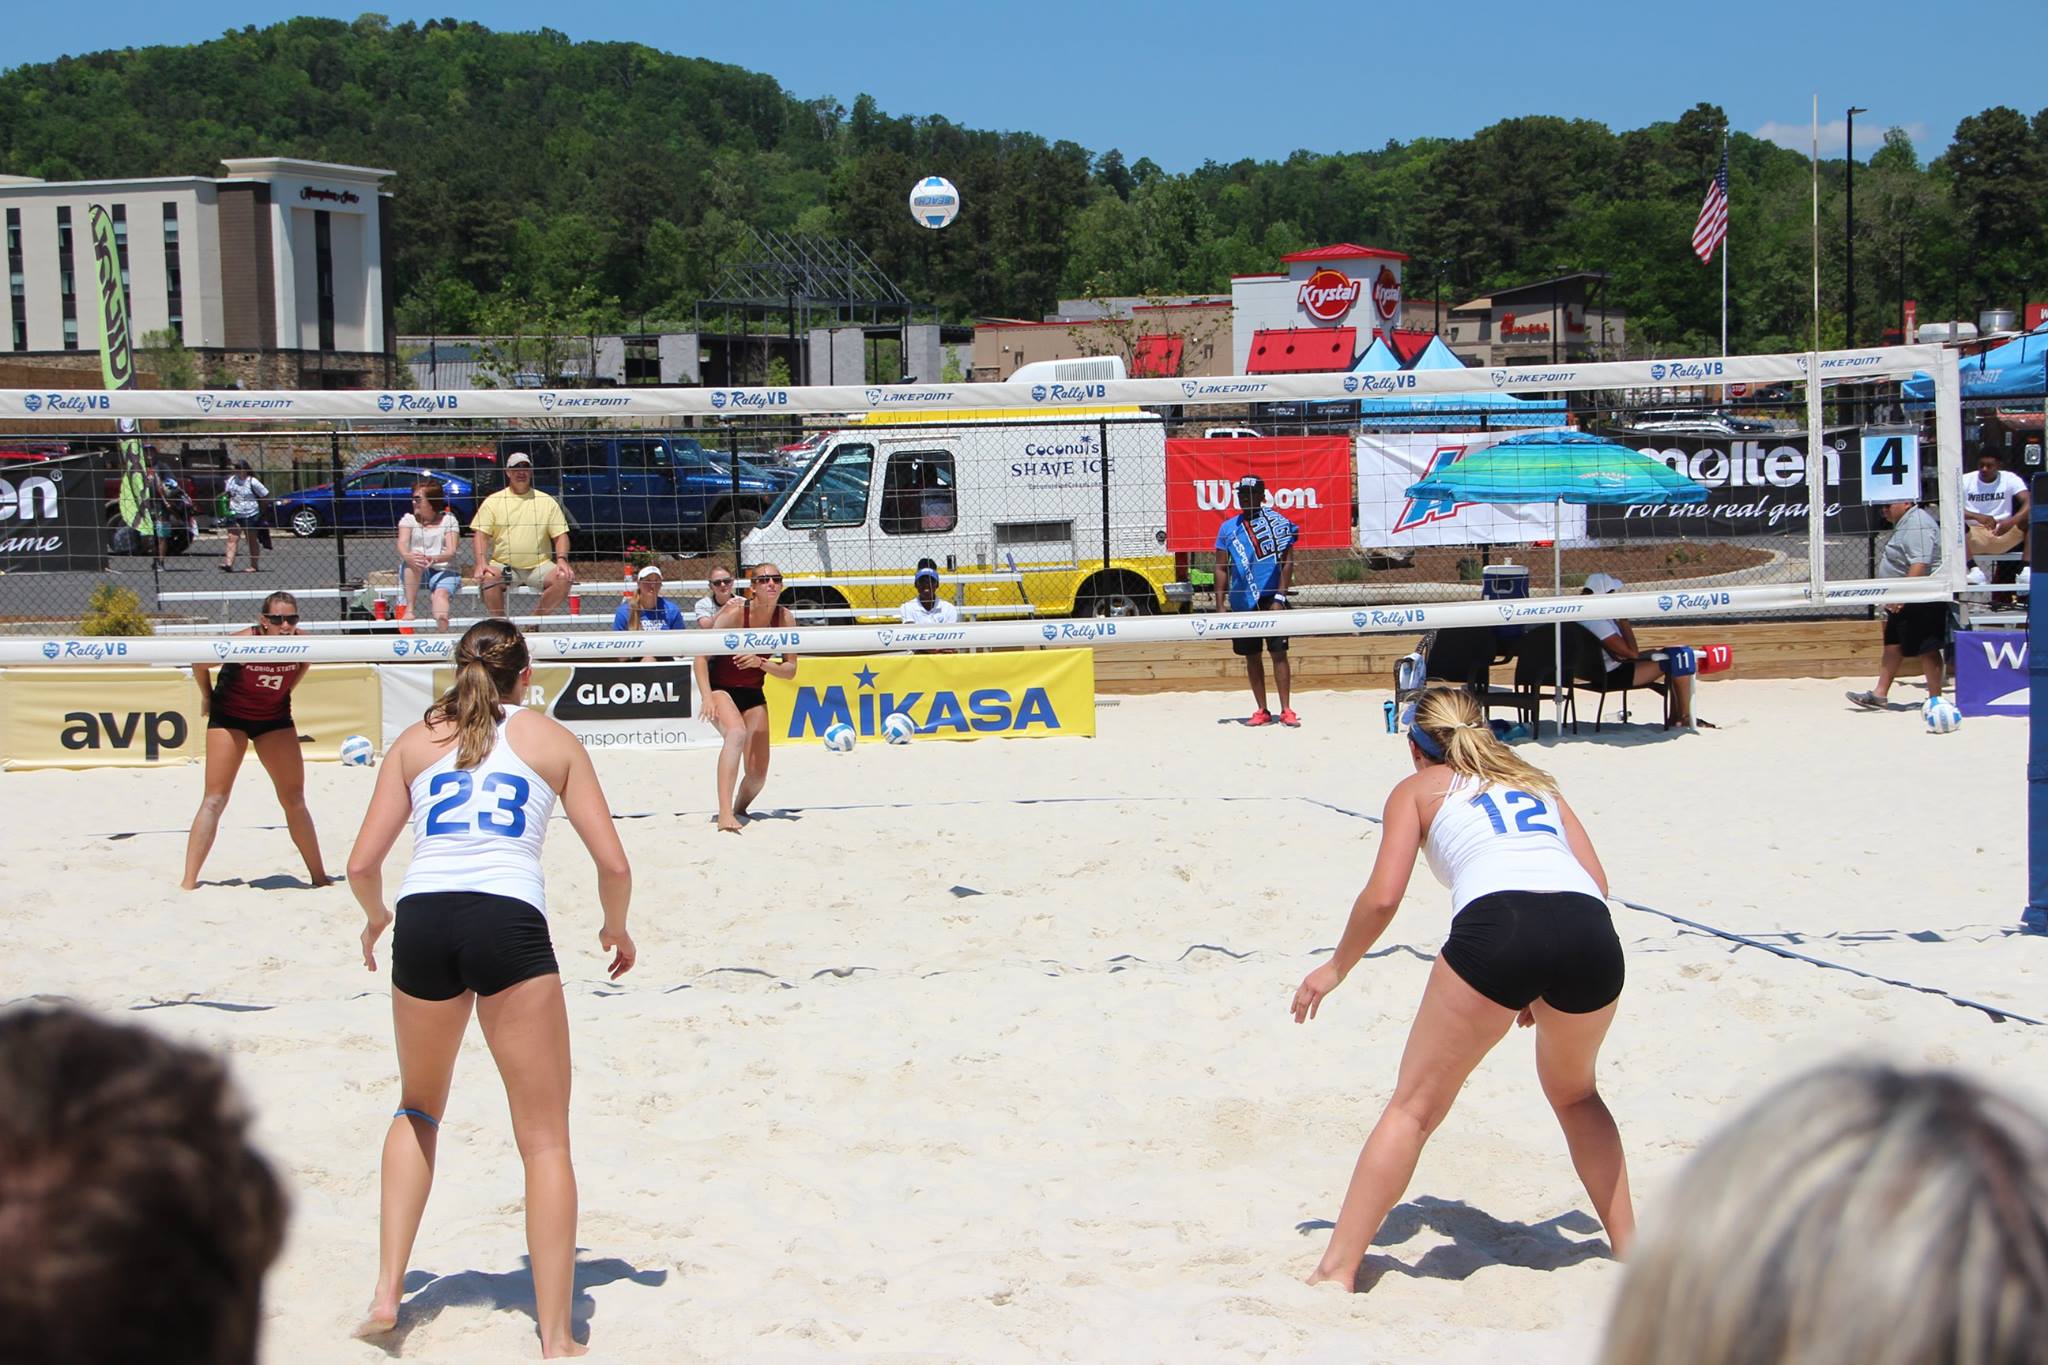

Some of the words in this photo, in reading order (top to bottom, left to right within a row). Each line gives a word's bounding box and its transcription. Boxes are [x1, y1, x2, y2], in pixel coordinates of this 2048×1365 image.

[1299, 283, 1358, 307] Krystal
[1375, 284, 1400, 306] Krystal
[1820, 356, 1883, 368] AKEPOINT
[1508, 372, 1575, 382] LAKEPOINT
[1199, 383, 1268, 393] LAKEPOINT
[558, 397, 630, 406] LAKEPOINT
[883, 392, 954, 402] LAKEPOINT
[217, 400, 294, 409] LAKEPOINT
[1011, 460, 1074, 478] SHAVE
[1083, 457, 1115, 473] ICE
[1871, 437, 1908, 485] 4
[1193, 479, 1317, 510] Wison
[1712, 494, 1770, 519] real
[1826, 588, 1889, 598] AKEPOINT
[1516, 604, 1583, 616] LAKEPOINT
[1209, 620, 1277, 630] LAKEPOINT
[896, 632, 965, 642] LAKEPOINT
[233, 645, 309, 655] LAKEPOINT
[572, 640, 644, 650] LAKEPOINT
[1676, 652, 1689, 669] 11
[1712, 646, 1727, 663] 17
[246, 664, 274, 673] FLORIDA
[276, 664, 296, 672] STATE
[255, 675, 284, 690] 33
[576, 682, 680, 706] GLOBAL
[61, 710, 188, 761] avp
[426, 770, 529, 838] 23
[1471, 790, 1558, 836] 12
